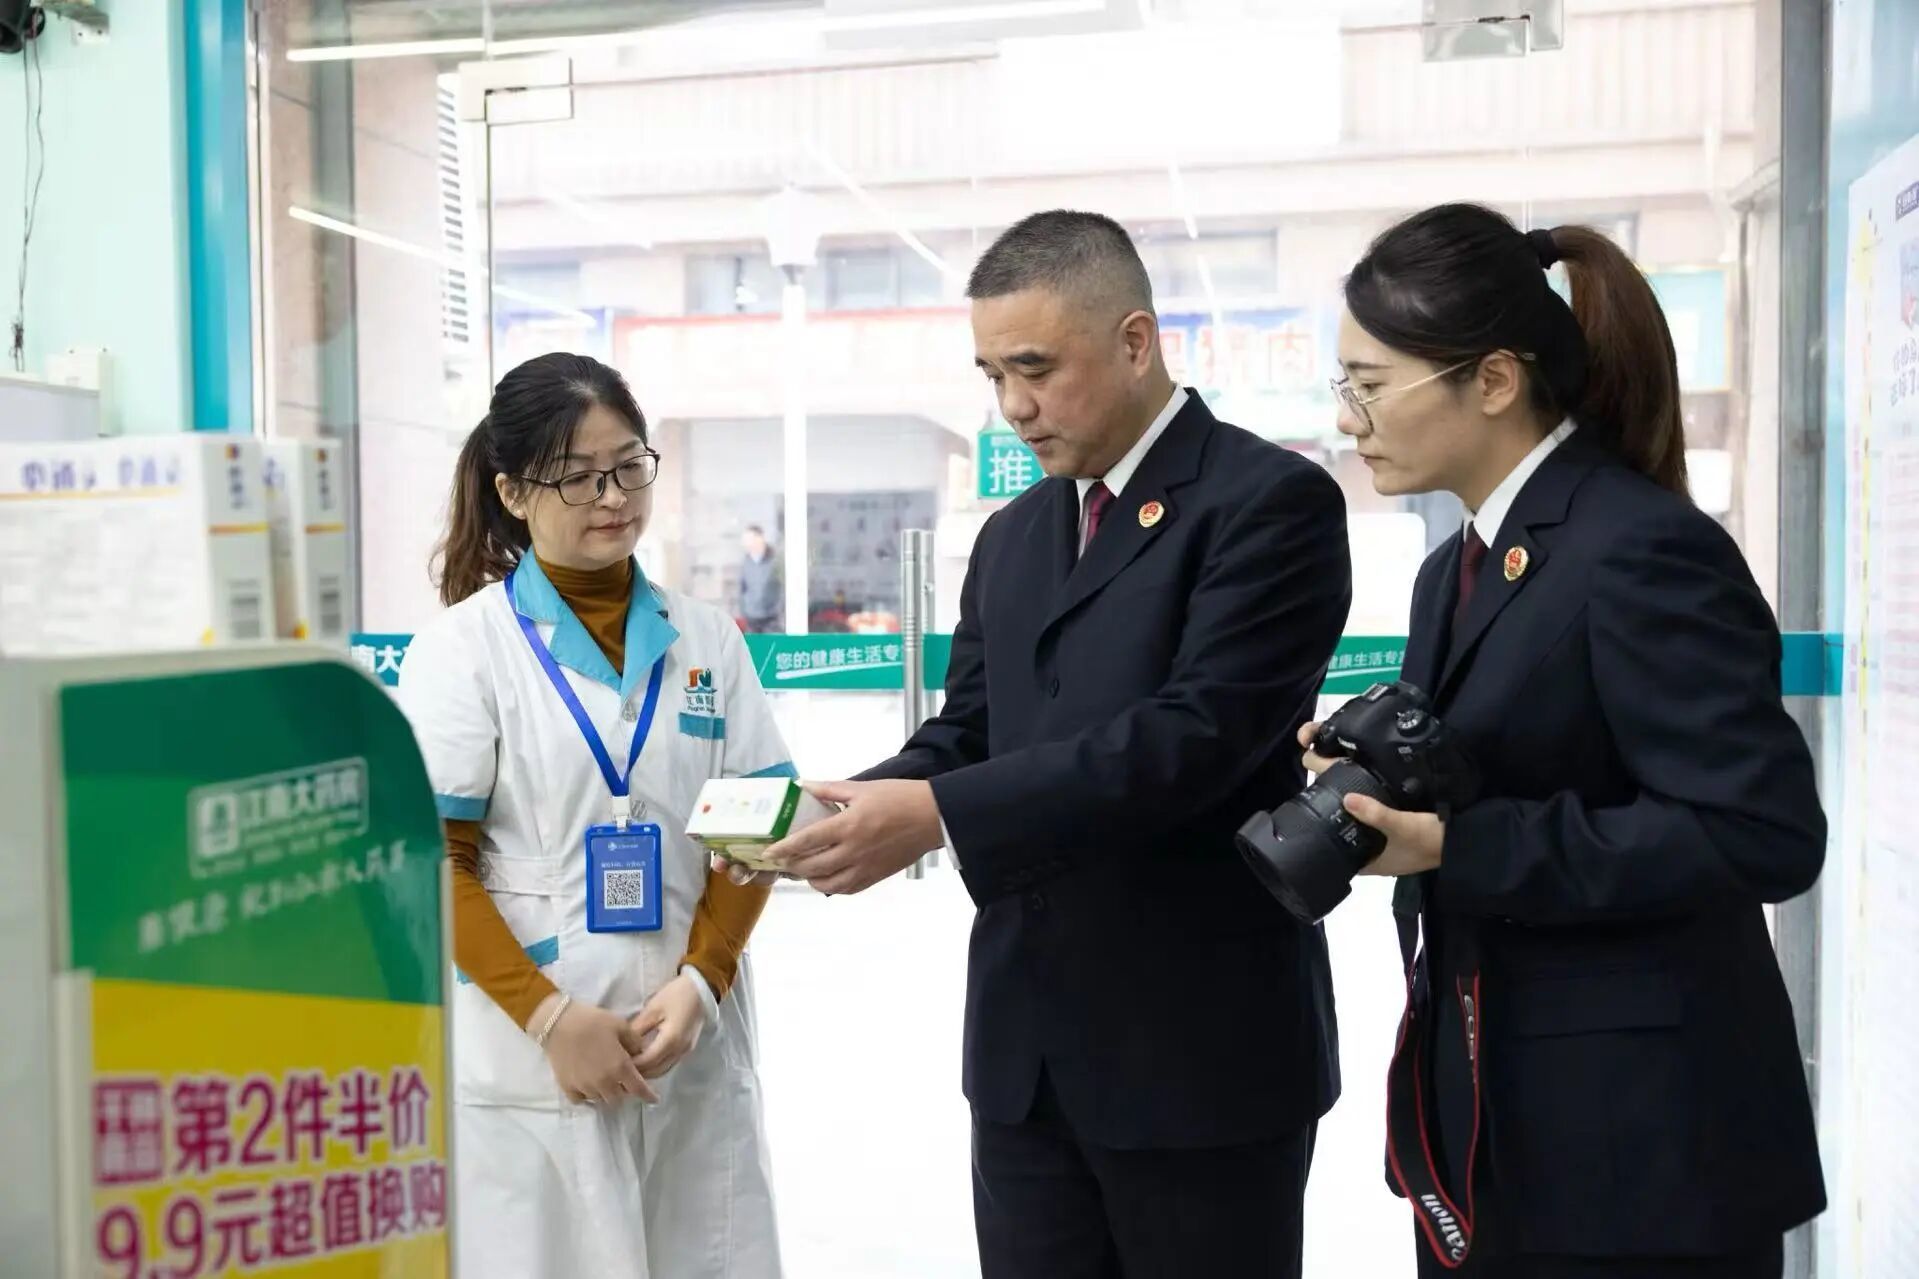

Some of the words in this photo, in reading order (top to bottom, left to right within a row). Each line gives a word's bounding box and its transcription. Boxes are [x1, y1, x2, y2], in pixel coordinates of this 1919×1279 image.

[989, 449, 1033, 493] 推
[173, 1071, 430, 1174] 第2件半价
[98, 1163, 447, 1279] 9.9元超值换购
